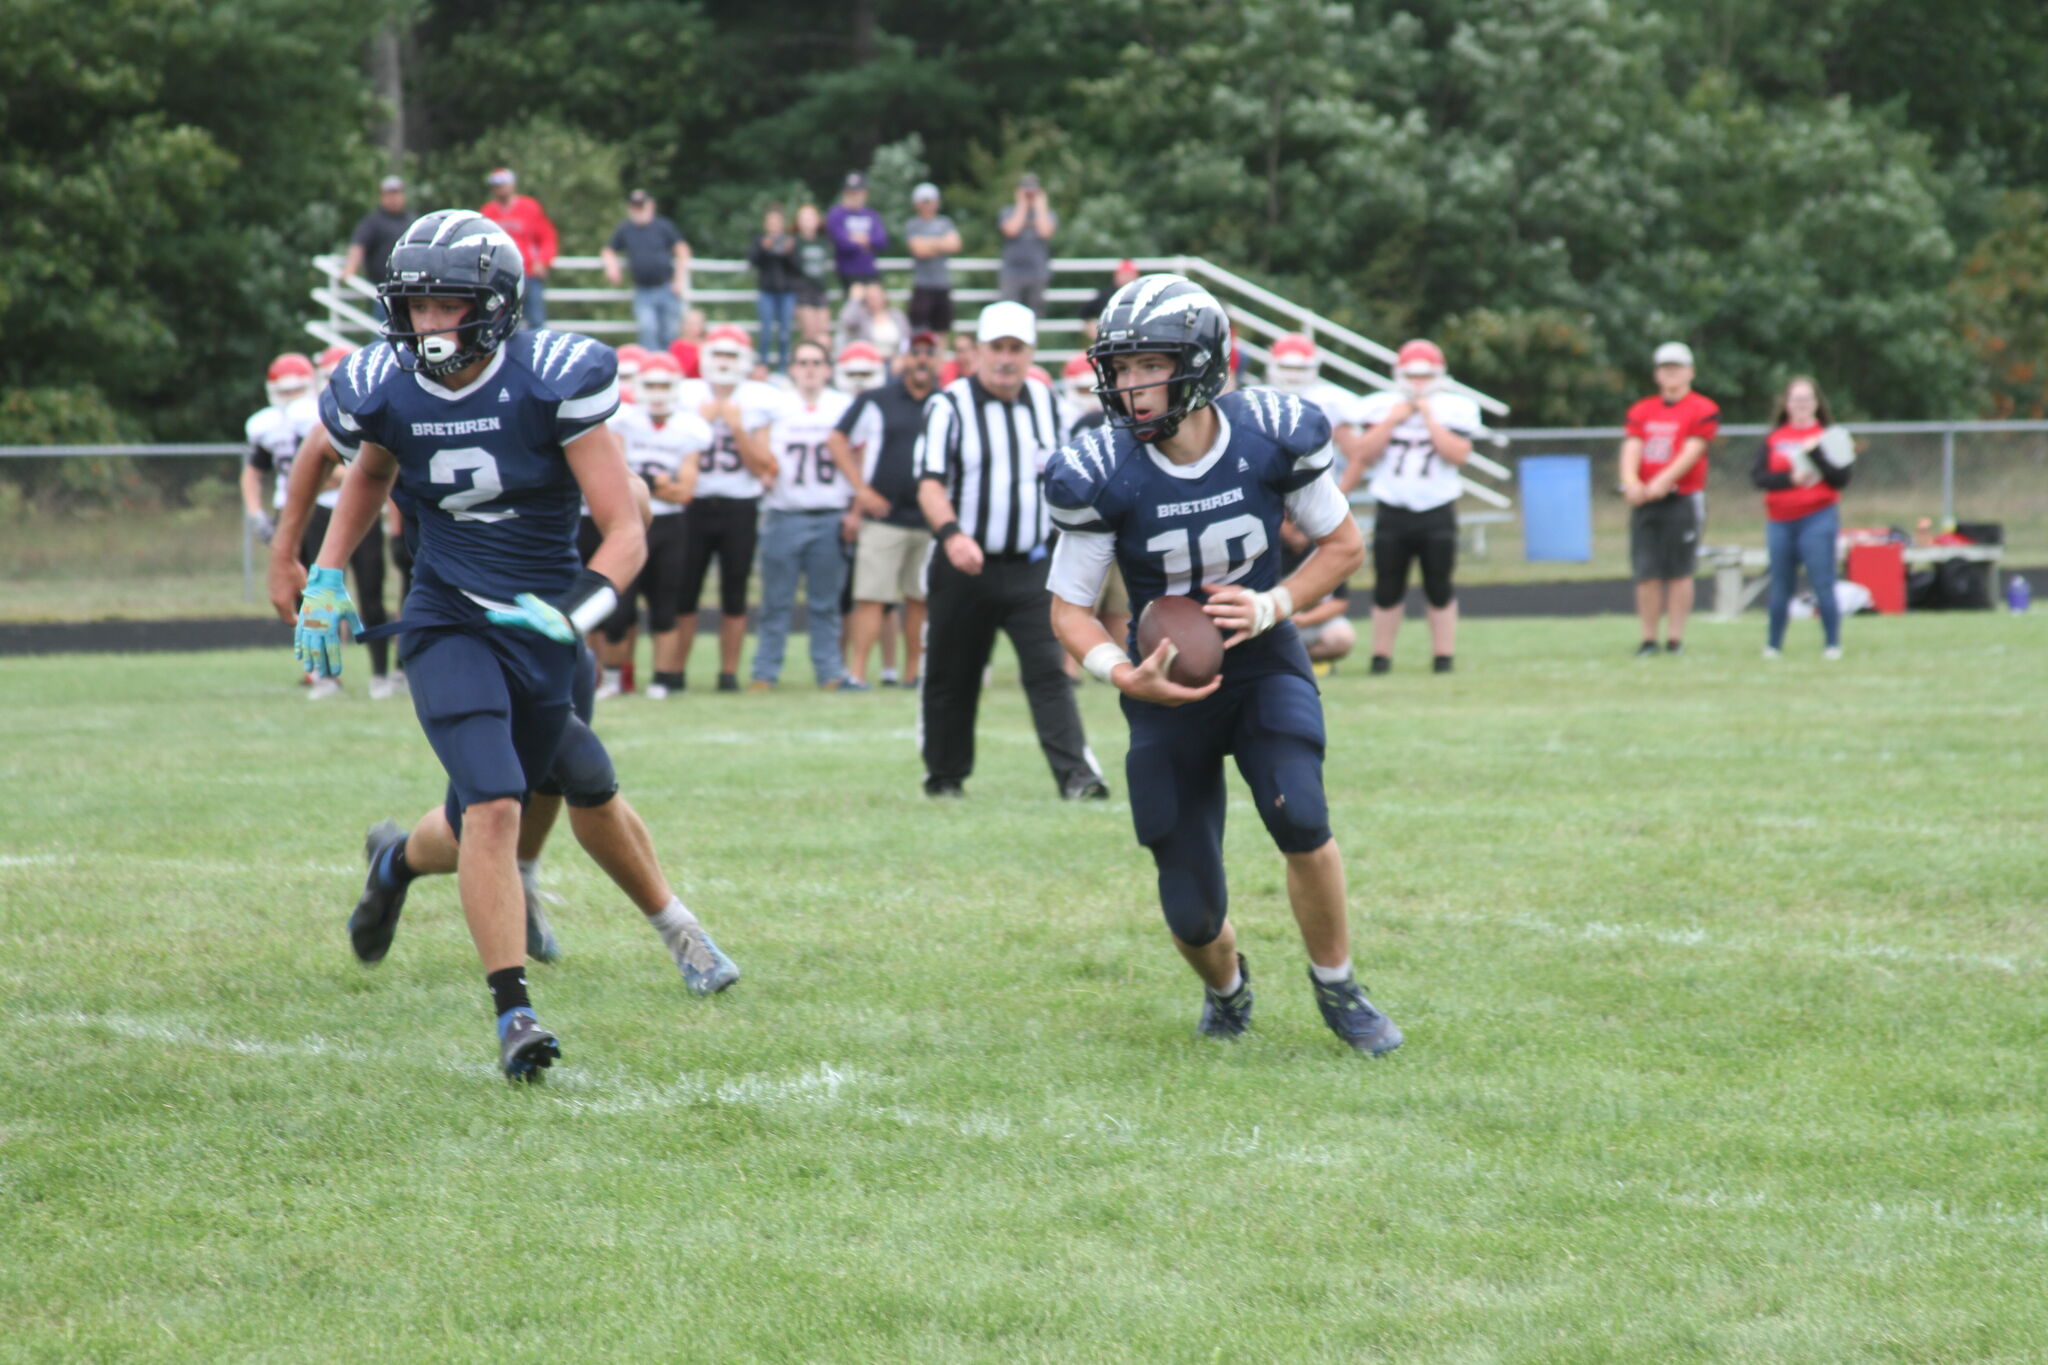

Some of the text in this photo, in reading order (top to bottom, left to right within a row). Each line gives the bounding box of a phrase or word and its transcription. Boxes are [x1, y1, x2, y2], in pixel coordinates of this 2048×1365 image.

[410, 416, 501, 436] BRETHREN
[1389, 438, 1438, 477] 77
[429, 446, 520, 524] 2
[1156, 487, 1245, 519] BRETHREN
[1146, 513, 1269, 596] 10
